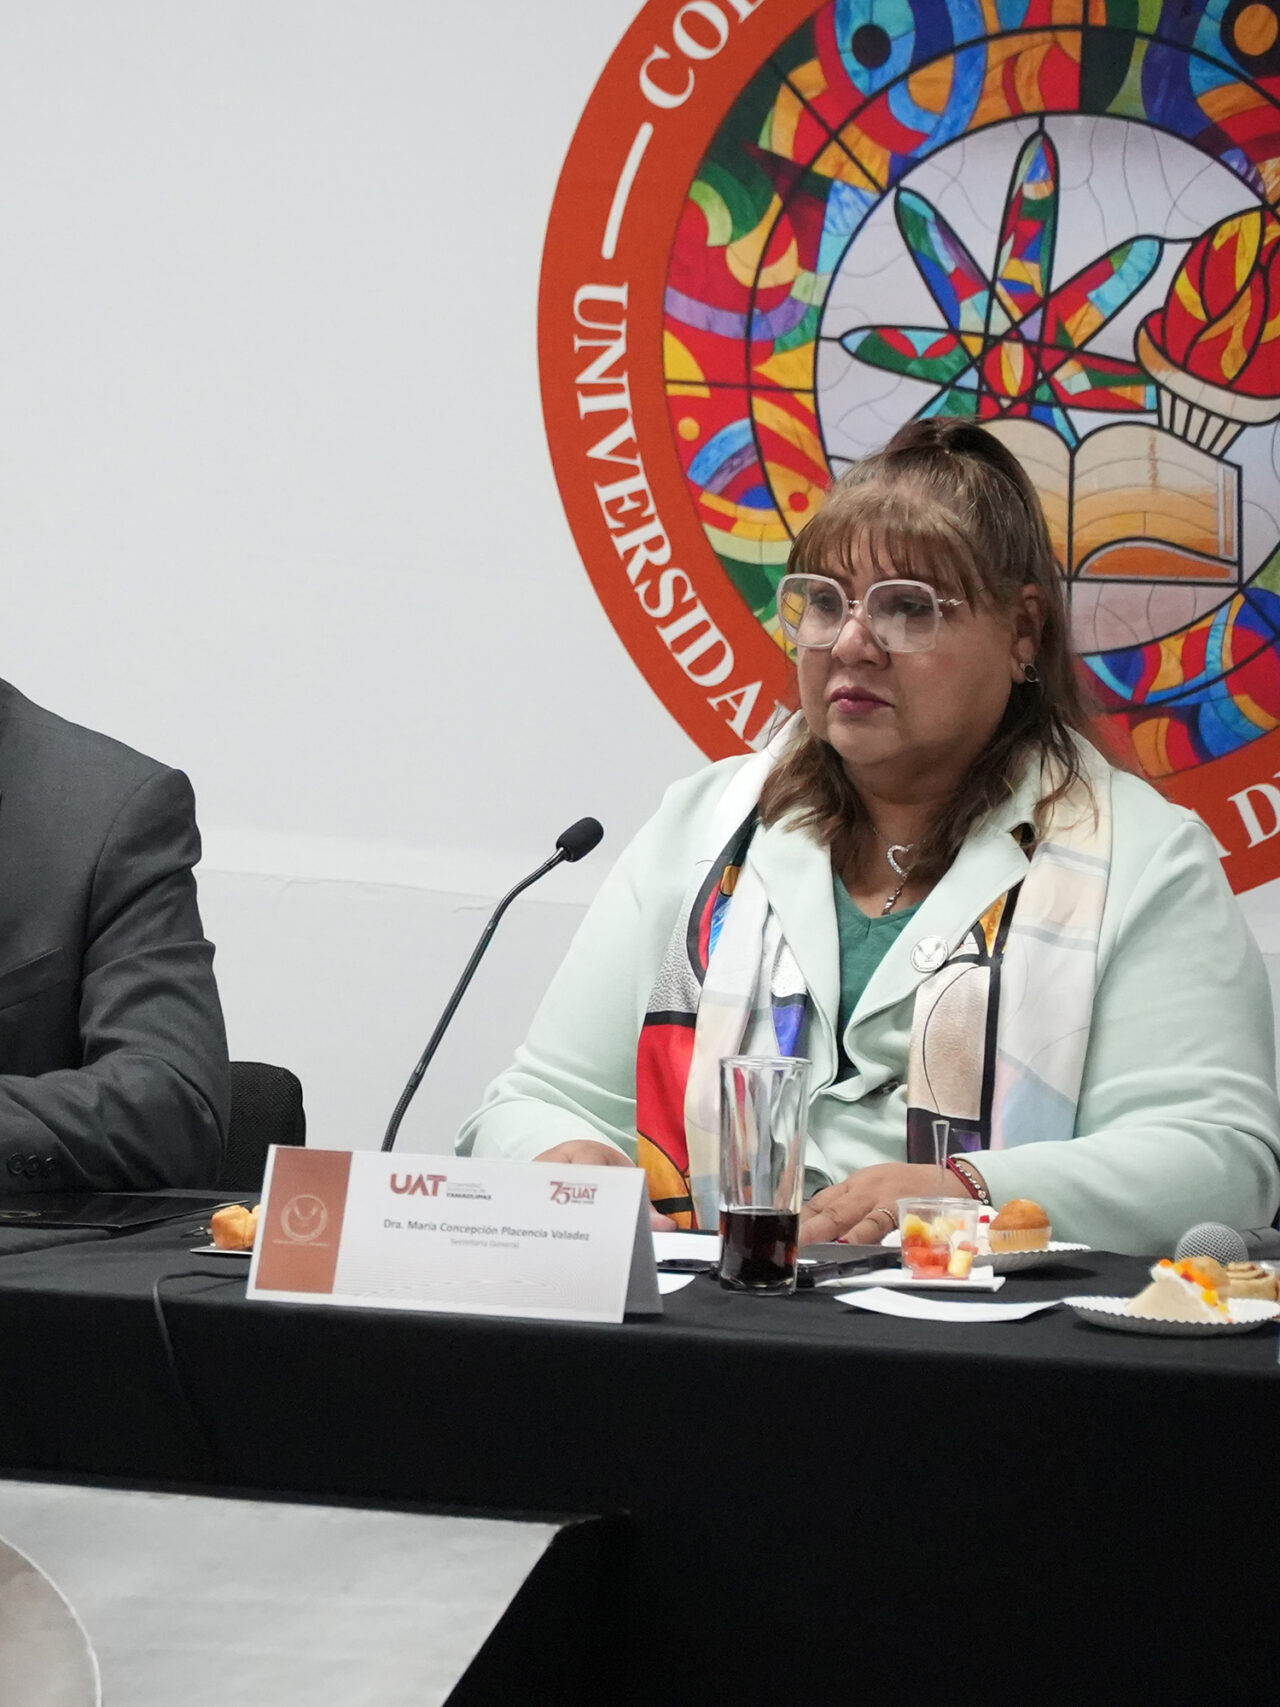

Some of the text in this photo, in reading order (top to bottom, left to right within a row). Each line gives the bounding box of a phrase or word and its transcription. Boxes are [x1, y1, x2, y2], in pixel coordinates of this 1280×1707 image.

[390, 1173, 447, 1197] UAT
[383, 1219, 404, 1230] Dra.
[440, 1222, 498, 1236] Concepción
[500, 1226, 548, 1239] Placencia
